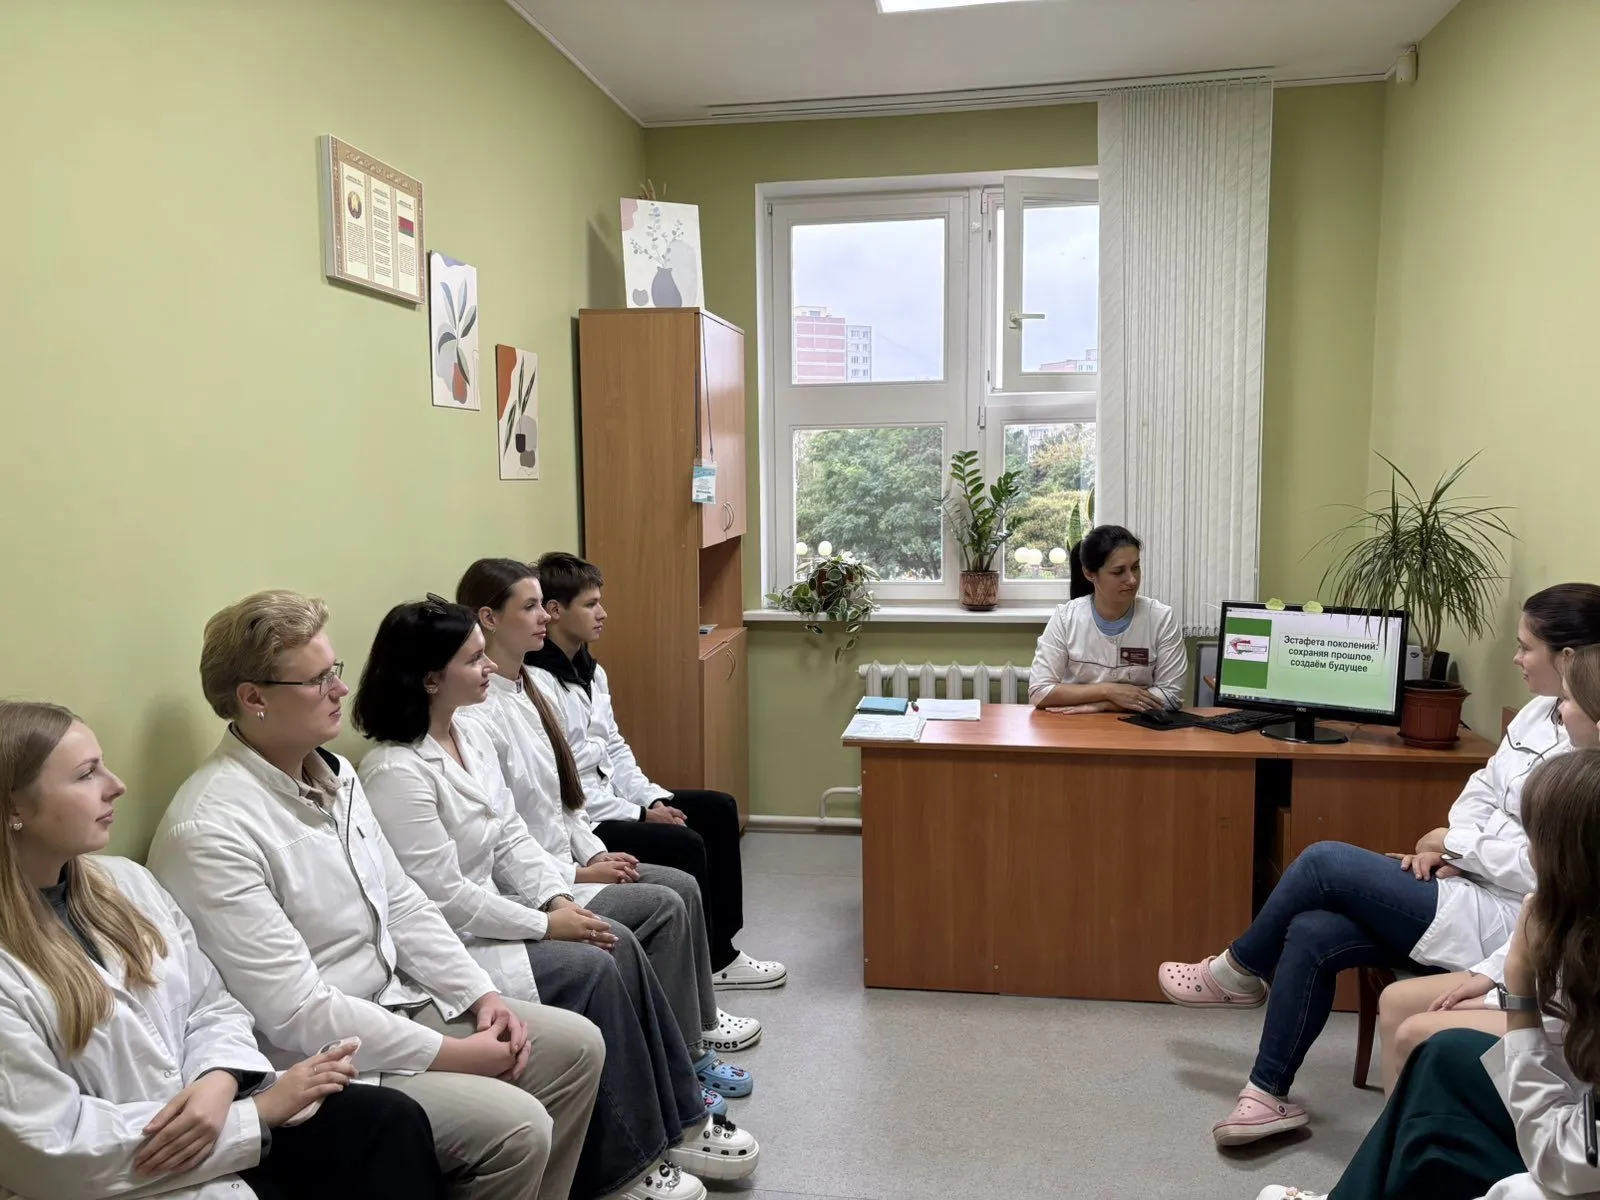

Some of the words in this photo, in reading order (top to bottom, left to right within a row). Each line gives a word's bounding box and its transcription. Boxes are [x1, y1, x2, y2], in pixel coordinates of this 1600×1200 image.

[1284, 635, 1325, 647] Эстафета
[1327, 639, 1379, 651] поколений:
[1288, 648, 1329, 658] сохраняя
[1331, 651, 1374, 662] прошлое,
[1290, 659, 1326, 669] создаём
[1328, 661, 1368, 673] будущее
